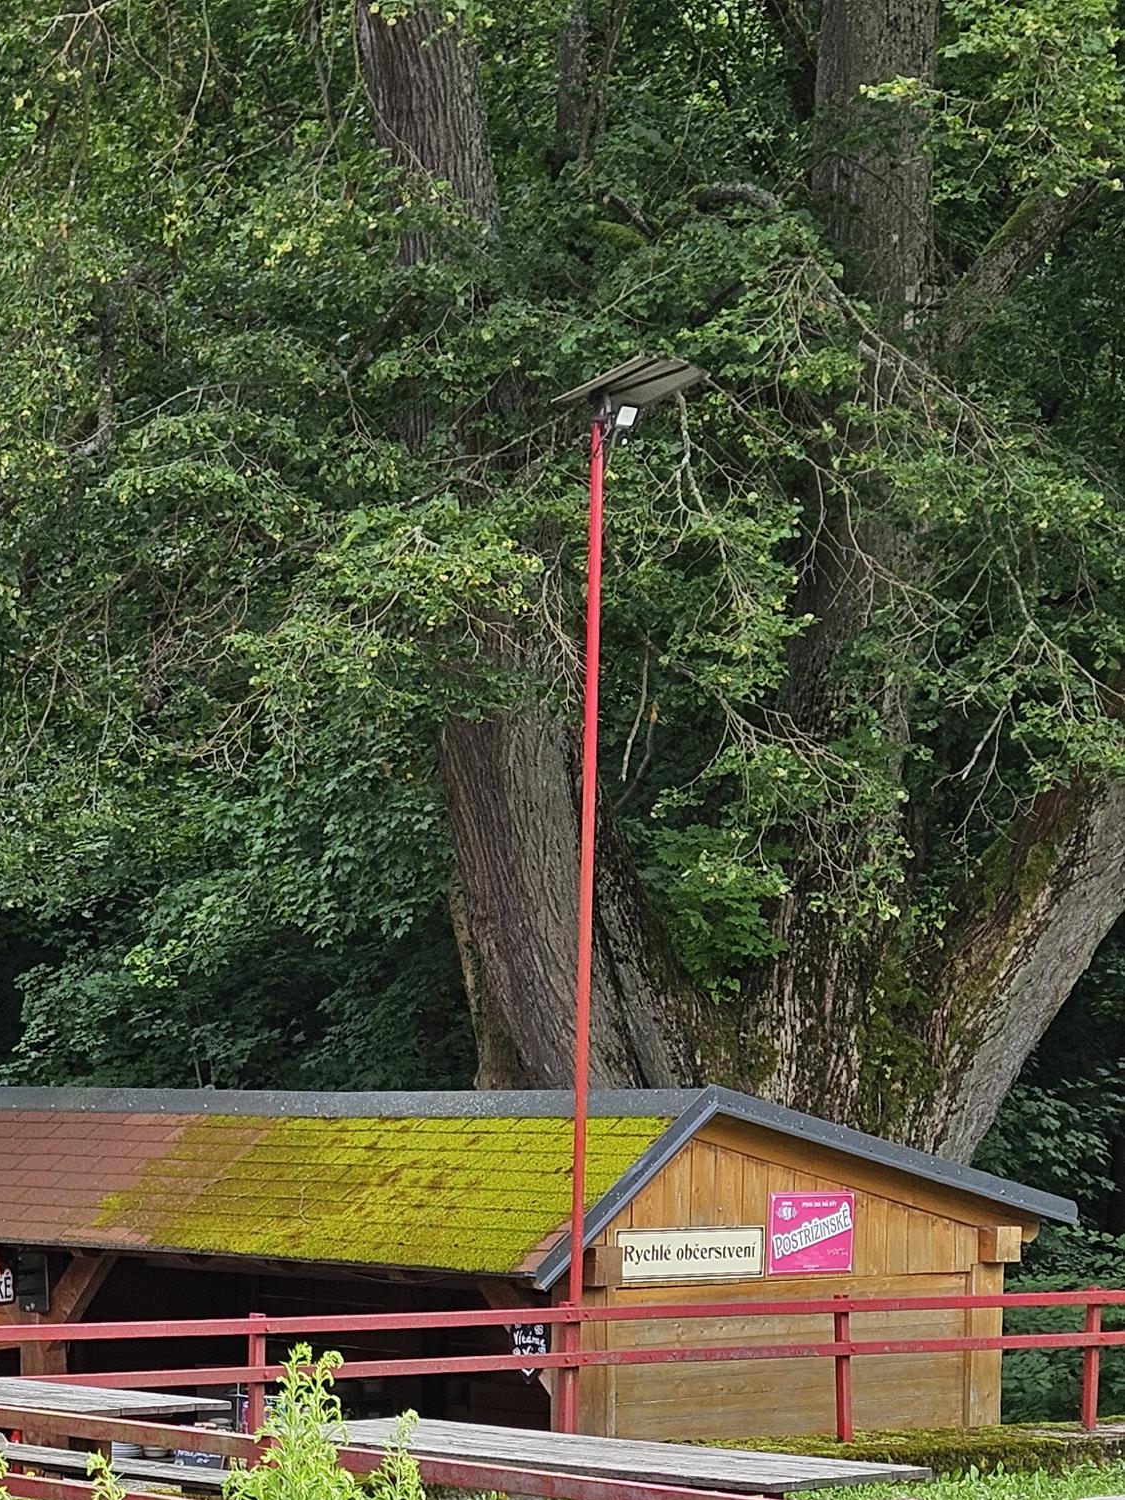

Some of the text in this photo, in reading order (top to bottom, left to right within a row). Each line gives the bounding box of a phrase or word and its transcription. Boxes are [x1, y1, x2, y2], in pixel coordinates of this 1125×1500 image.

[774, 1204, 850, 1257] POSTŘIŽINSKÉ
[624, 1241, 757, 1265] Rychlé občerstvení
